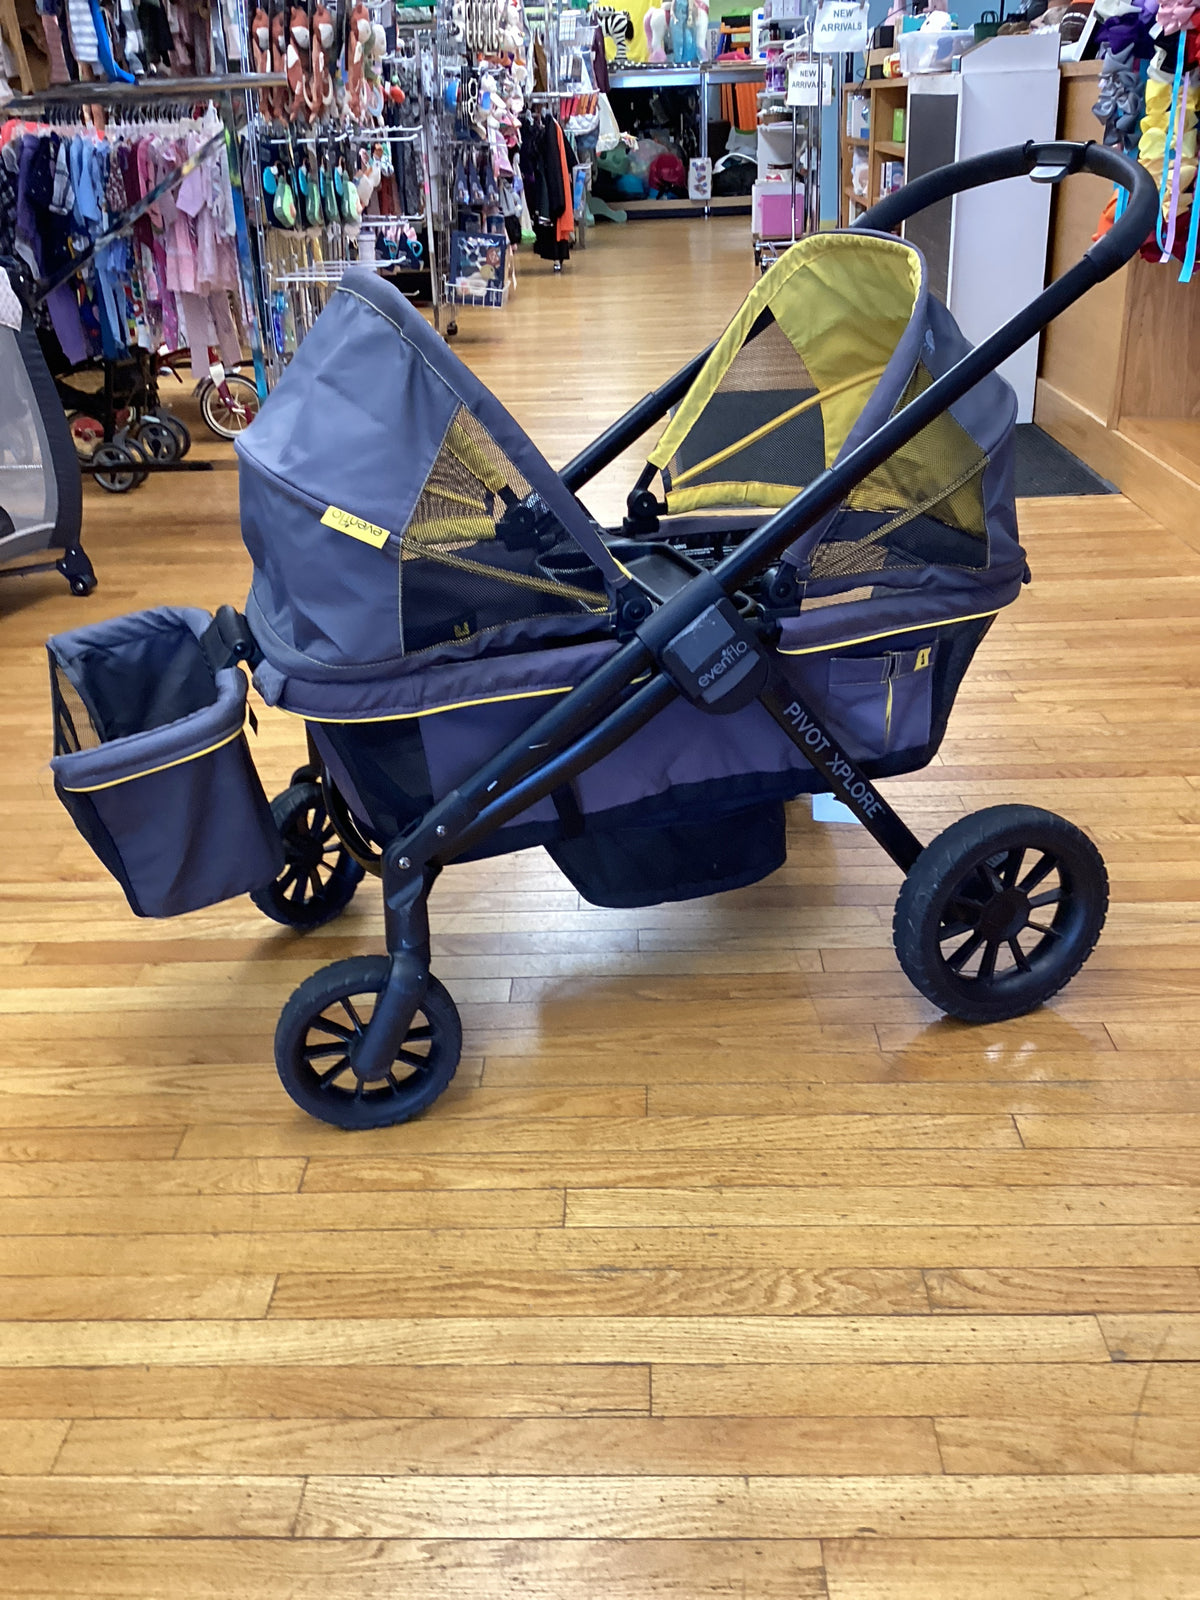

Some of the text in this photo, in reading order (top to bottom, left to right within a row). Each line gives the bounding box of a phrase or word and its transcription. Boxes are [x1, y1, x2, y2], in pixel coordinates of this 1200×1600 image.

[833, 9, 854, 18] NEW
[820, 22, 862, 32] ARRIVALS
[791, 80, 827, 89] ARRIVAS
[332, 509, 383, 537] evenflo
[698, 641, 748, 687] evenflo
[783, 701, 831, 753] PIVOT
